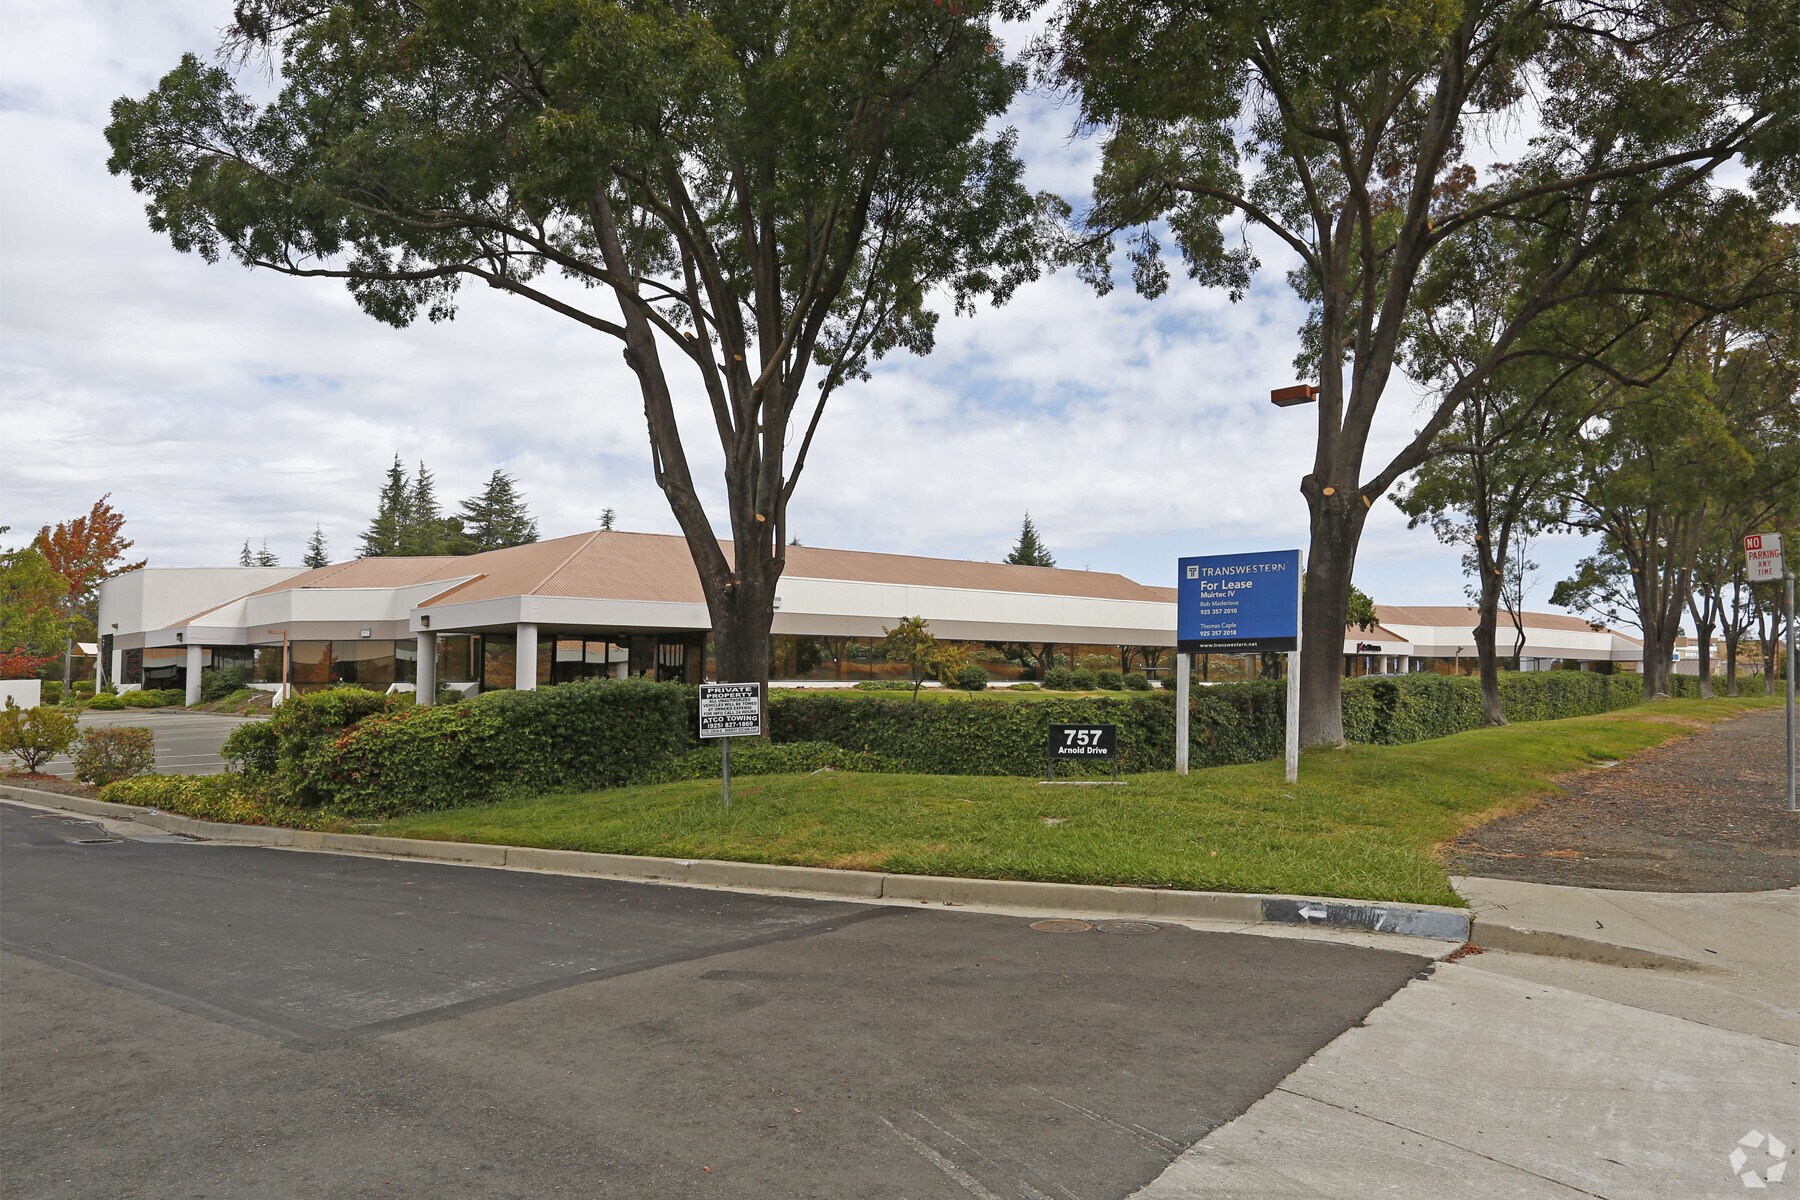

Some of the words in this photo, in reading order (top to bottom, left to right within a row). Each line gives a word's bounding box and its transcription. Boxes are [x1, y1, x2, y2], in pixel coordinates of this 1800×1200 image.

[1747, 538, 1759, 548] NO
[1748, 549, 1779, 560] PARKING
[1758, 560, 1771, 568] ANY
[1201, 563, 1286, 577] TRANSWESTERN
[1200, 581, 1219, 591] For
[1222, 580, 1253, 590] Lease
[1200, 591, 1226, 599] Muirtec
[703, 716, 724, 724] ATCO
[1064, 730, 1102, 745] 757
[1087, 746, 1108, 754] Drive
